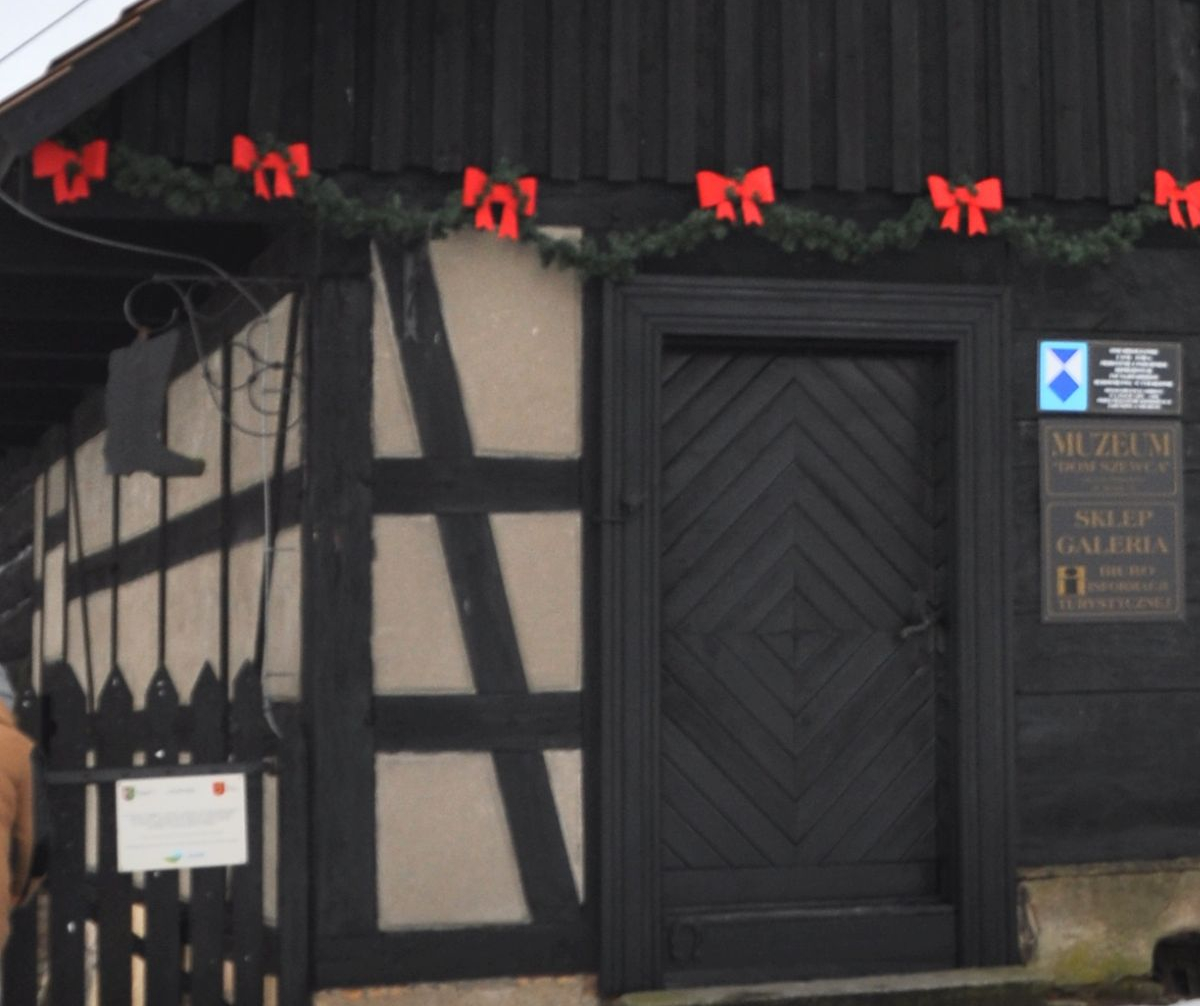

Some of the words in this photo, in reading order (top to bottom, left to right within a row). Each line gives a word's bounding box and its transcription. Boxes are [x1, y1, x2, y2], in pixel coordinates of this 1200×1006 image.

[1051, 431, 1171, 457] MUZEUM
[1074, 509, 1153, 528] SKLEP
[1055, 535, 1169, 555] GALERIA
